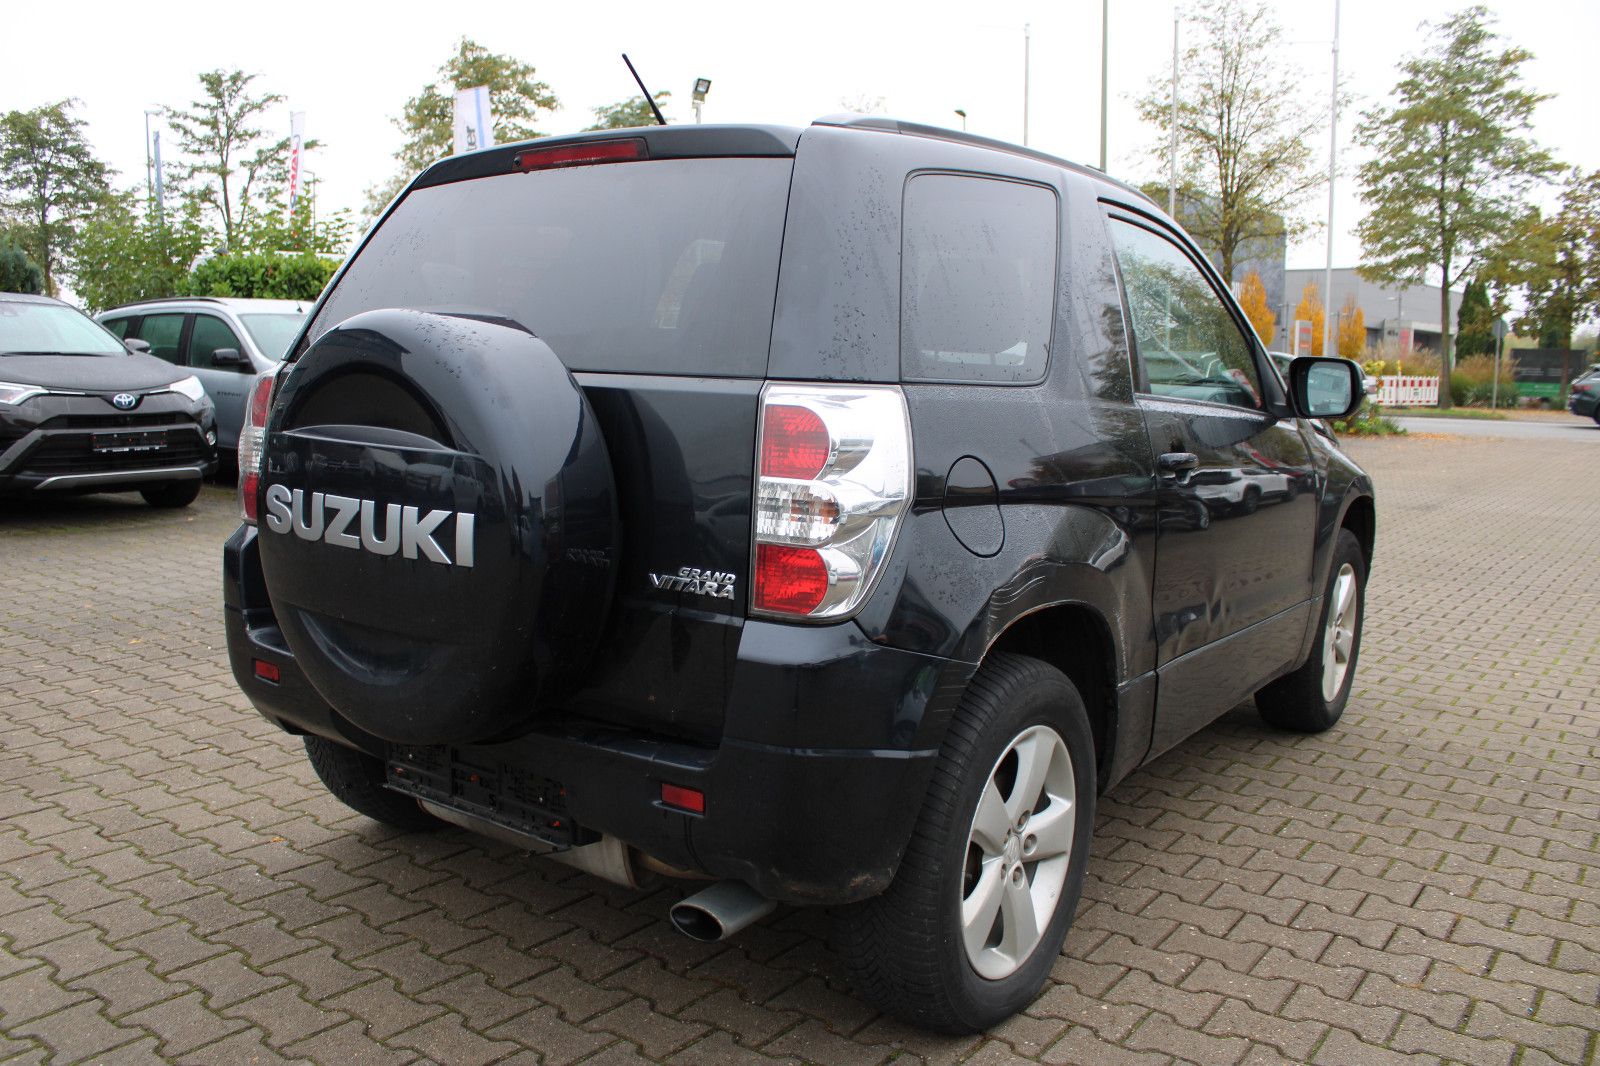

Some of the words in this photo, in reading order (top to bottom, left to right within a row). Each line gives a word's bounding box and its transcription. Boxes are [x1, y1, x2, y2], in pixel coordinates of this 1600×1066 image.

[266, 484, 475, 567] SUZUKI
[648, 573, 735, 600] VITARA
[678, 566, 736, 585] GRAND
